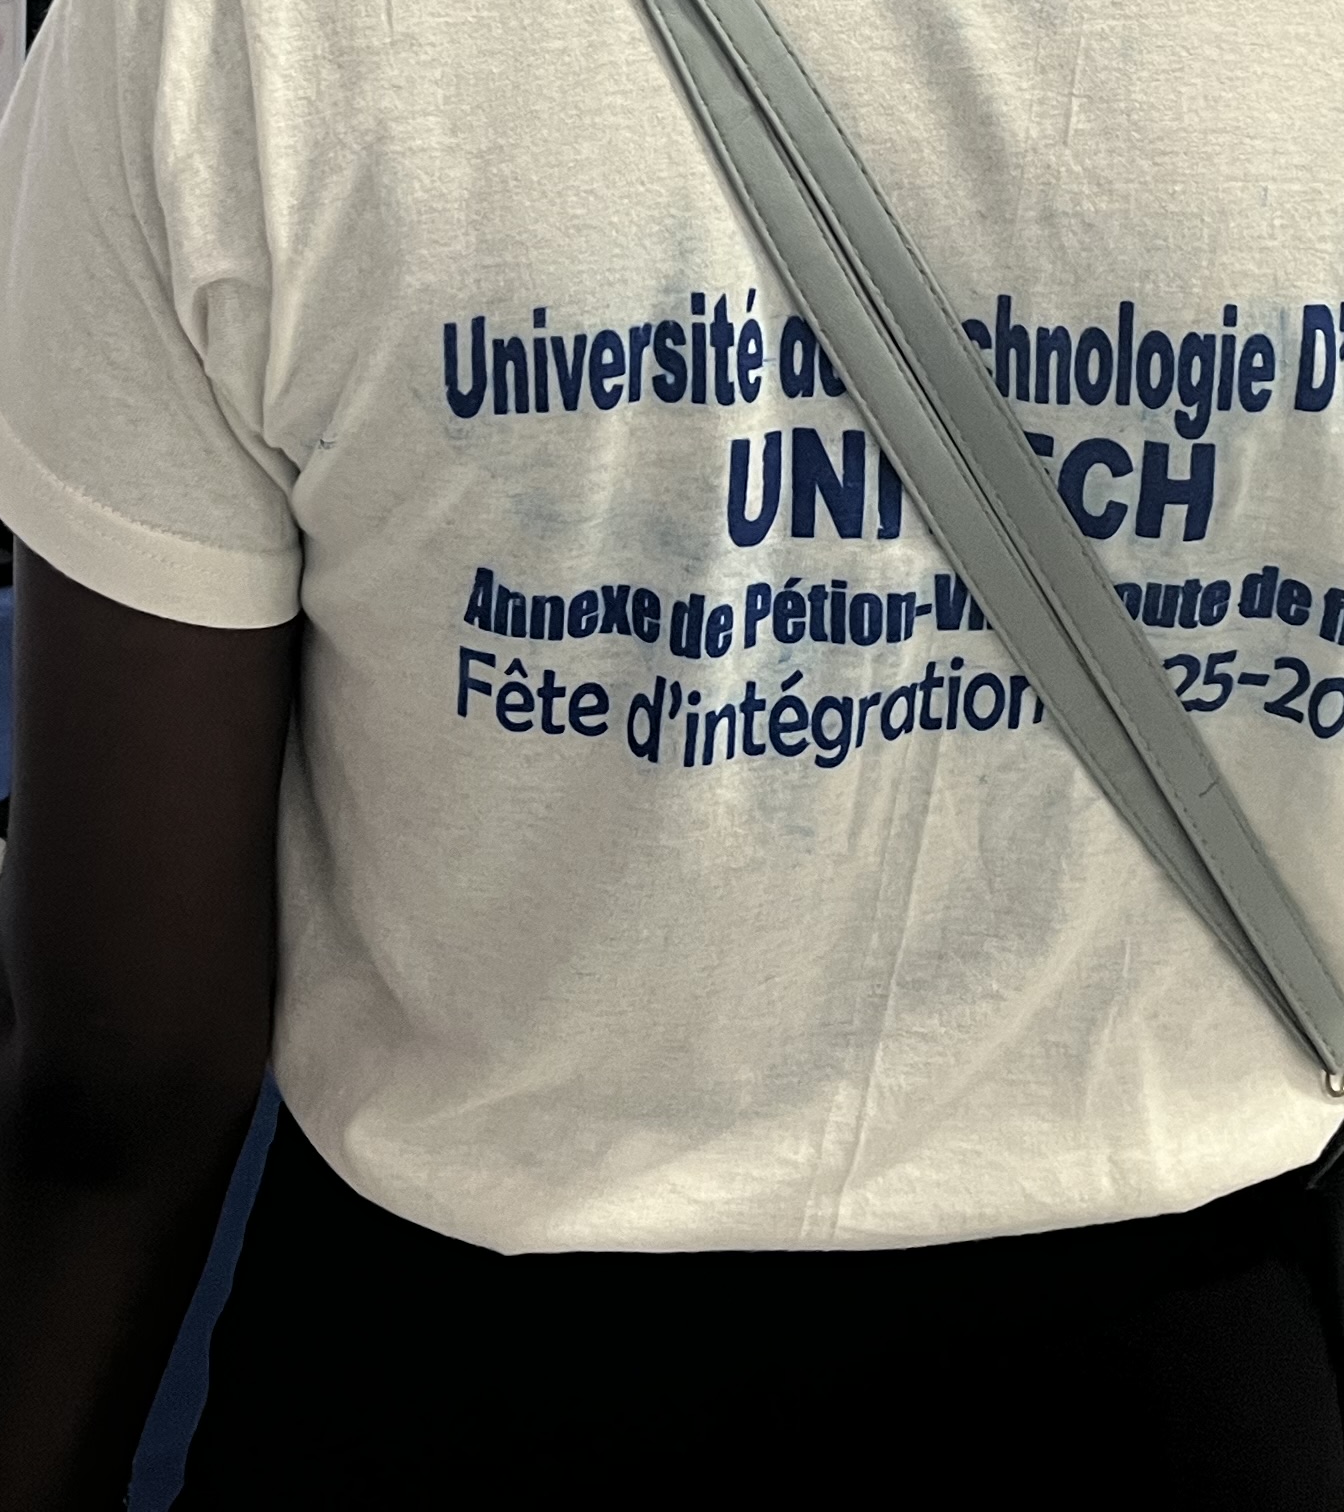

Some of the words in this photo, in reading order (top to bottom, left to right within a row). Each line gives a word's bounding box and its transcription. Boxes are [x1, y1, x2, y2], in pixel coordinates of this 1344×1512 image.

[443, 288, 764, 418] Université
[464, 567, 661, 643] Annexe
[670, 593, 734, 660] de
[1238, 565, 1312, 626] de
[457, 646, 610, 736] Fête
